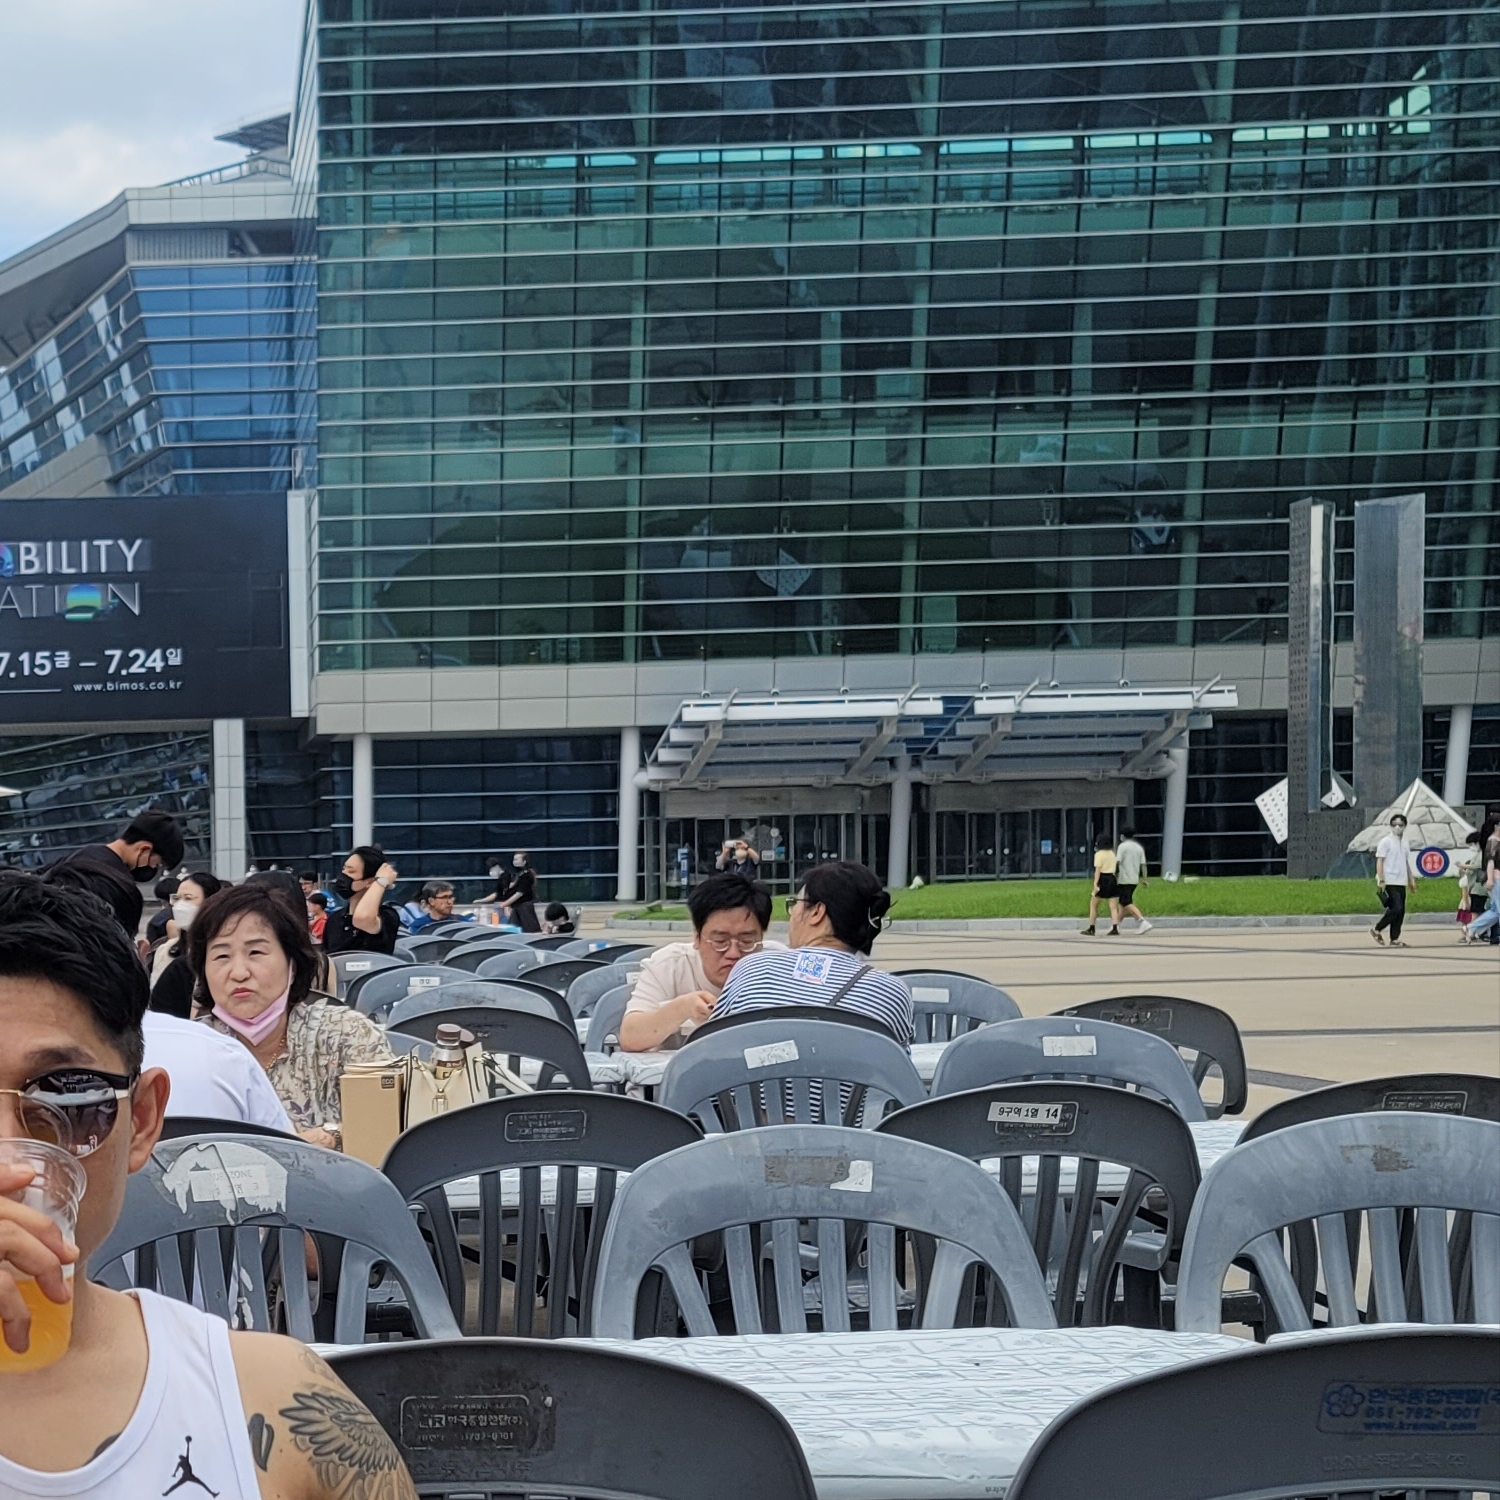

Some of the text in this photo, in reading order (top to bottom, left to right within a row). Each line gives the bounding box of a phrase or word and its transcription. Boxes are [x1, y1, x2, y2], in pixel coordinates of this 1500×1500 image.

[72, 680, 182, 692] www.bimos.co.kr
[998, 1106, 1022, 1118] 9구역
[1045, 1107, 1059, 1119] 14
